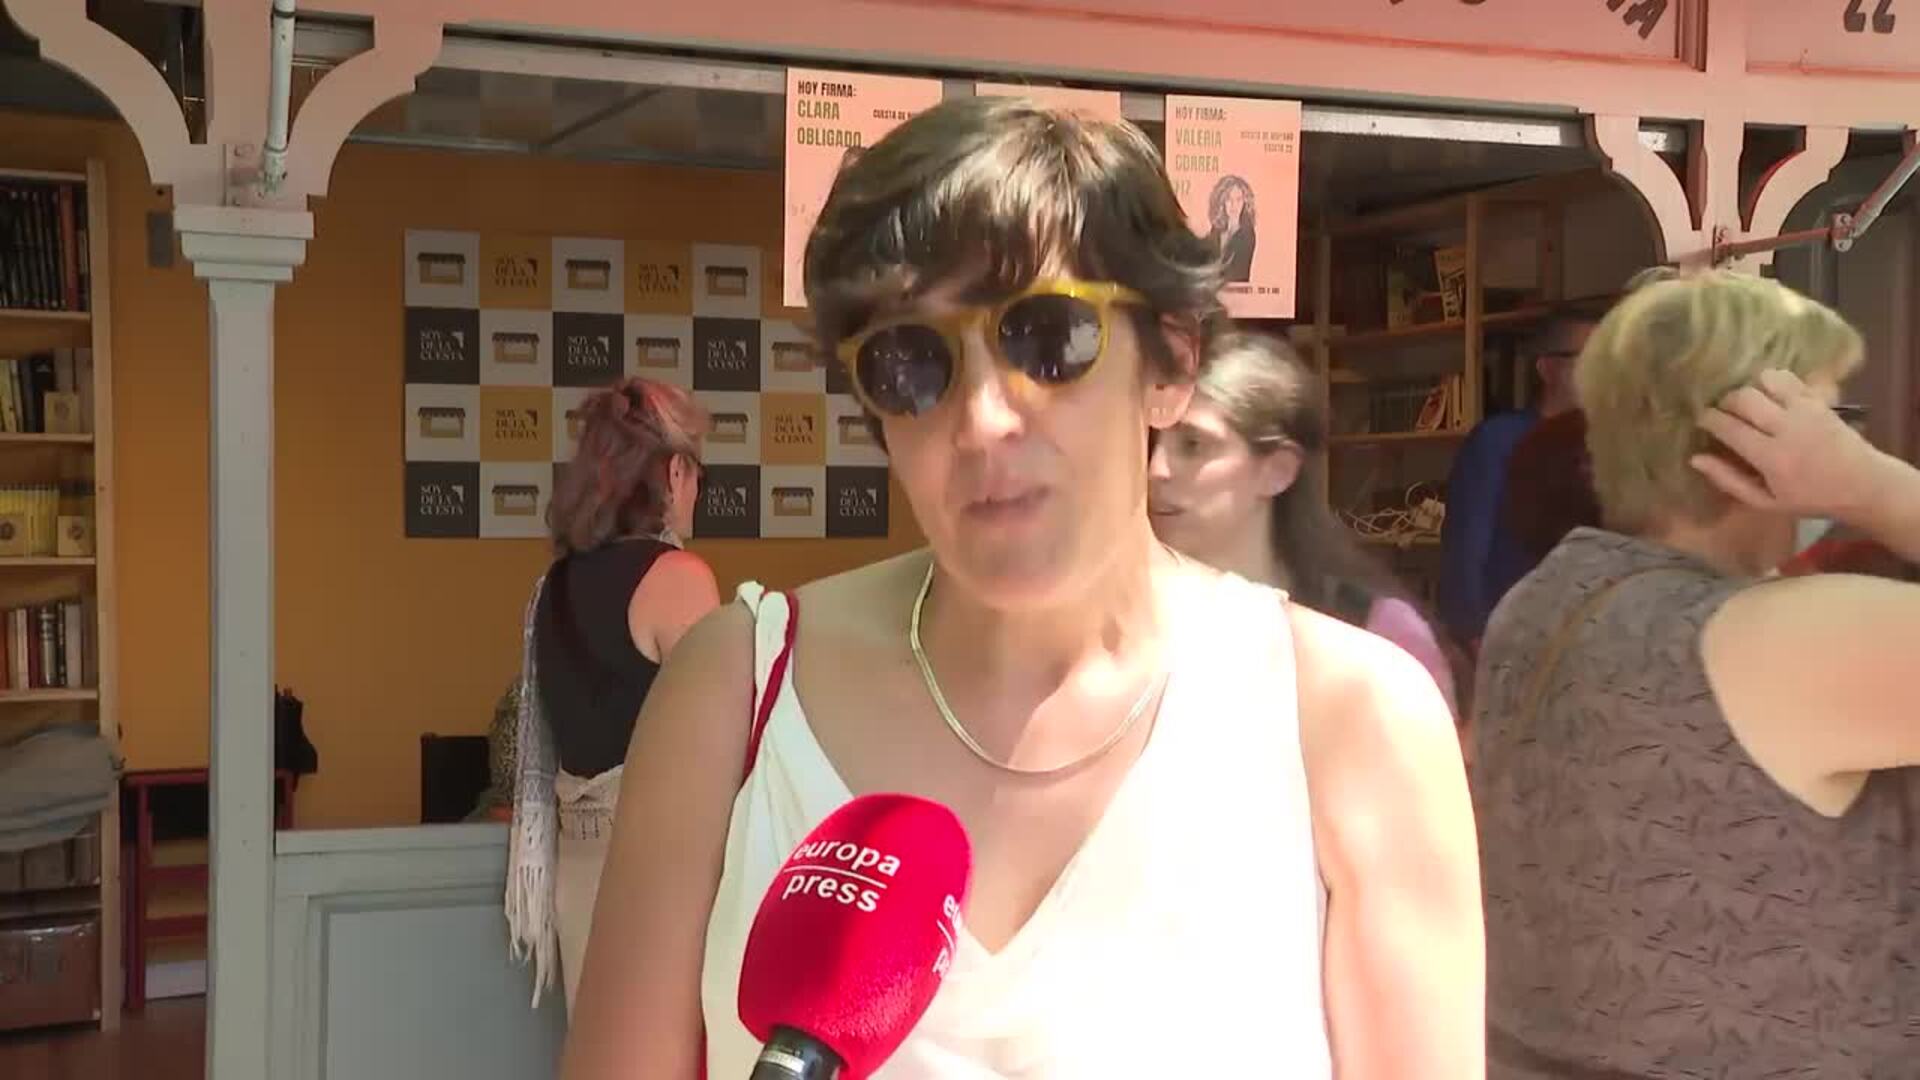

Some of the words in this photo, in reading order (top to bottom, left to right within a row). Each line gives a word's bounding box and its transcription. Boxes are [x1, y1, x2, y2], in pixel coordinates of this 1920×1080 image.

[797, 80, 817, 96] HOY
[821, 82, 857, 97] FIRMA:
[797, 99, 840, 120] CLARA
[1175, 106, 1193, 119] HOY
[797, 127, 862, 148] OBLIGADO
[1175, 128, 1222, 148] VALERIA
[1175, 155, 1220, 174] CORREA
[793, 840, 901, 877] europa
[782, 874, 880, 912] press
